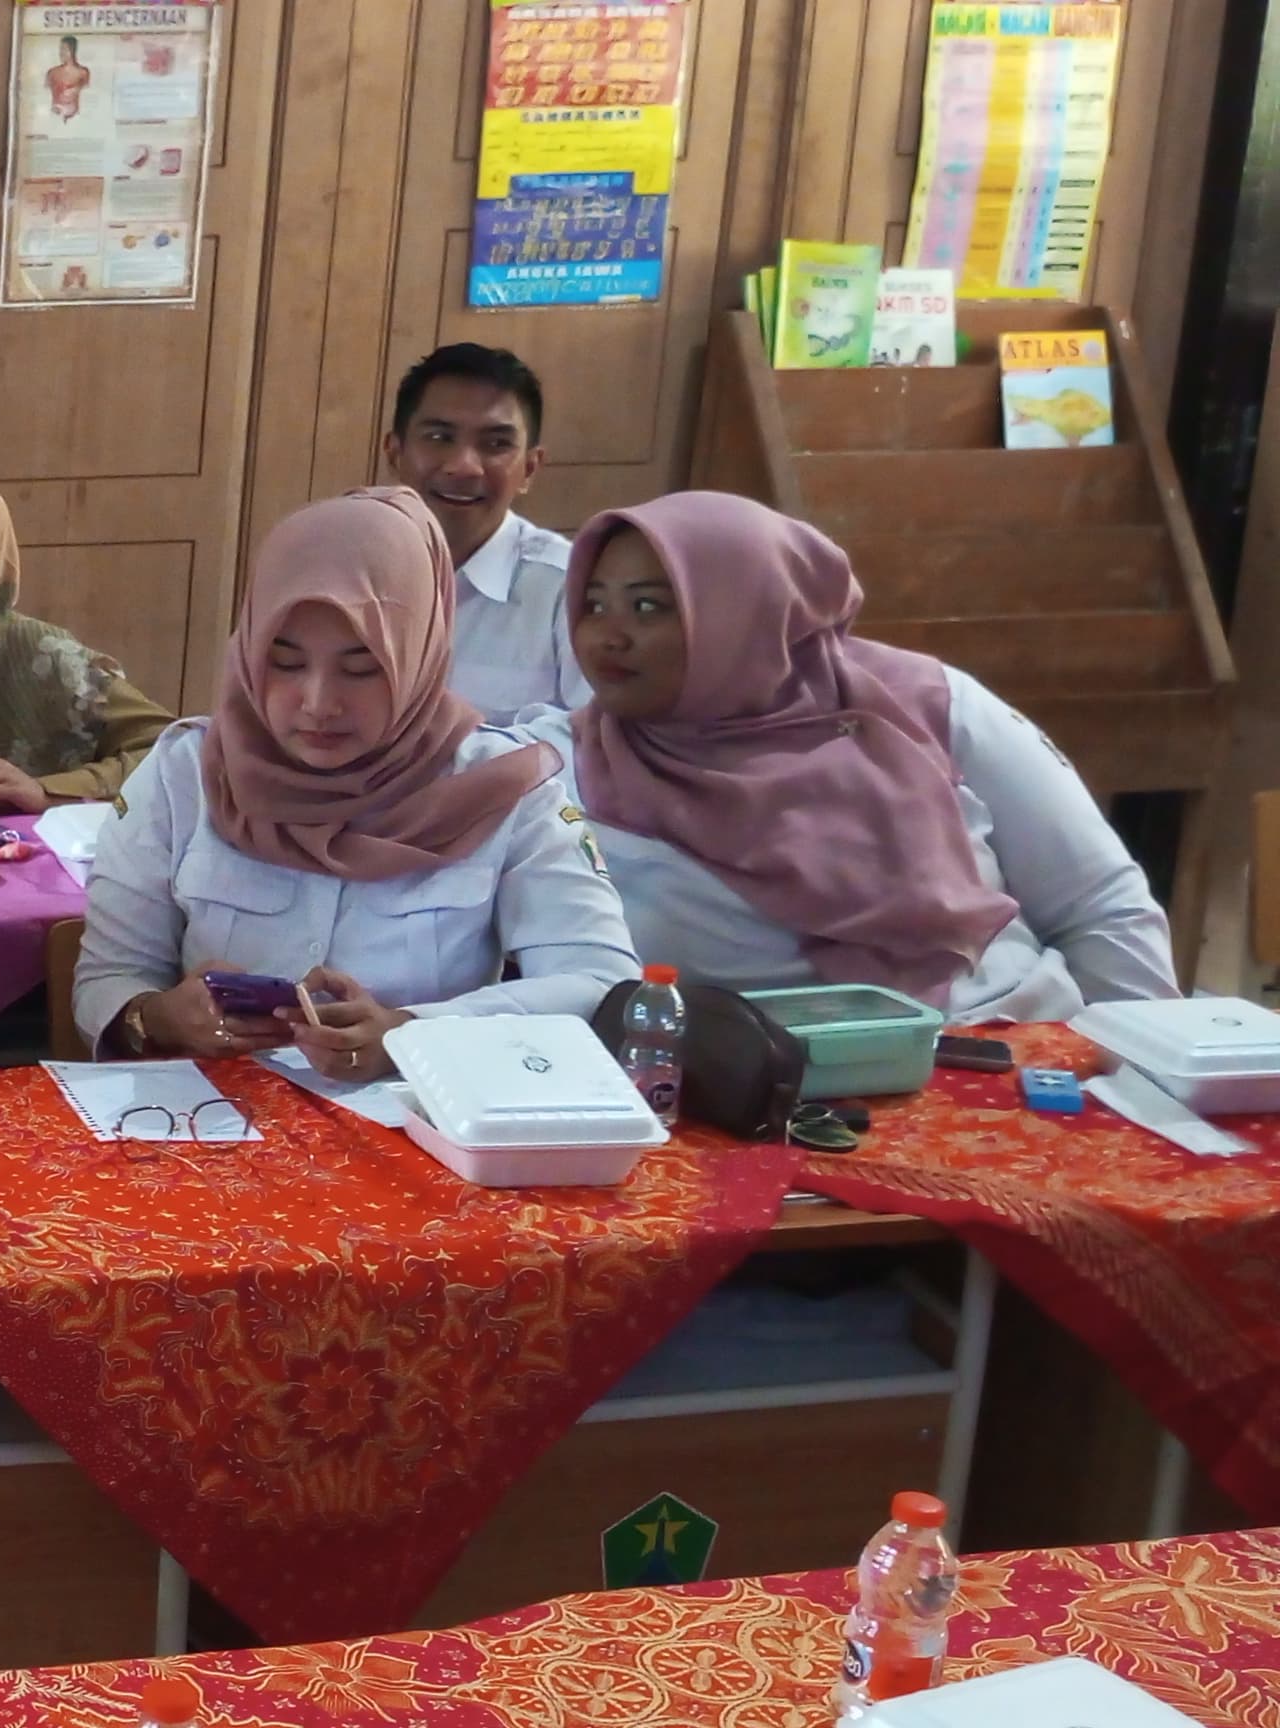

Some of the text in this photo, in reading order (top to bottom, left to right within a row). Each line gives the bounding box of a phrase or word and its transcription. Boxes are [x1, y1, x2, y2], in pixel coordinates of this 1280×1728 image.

[43, 9, 188, 28] SISTEM PENCERNAAN
[1004, 340, 1081, 360] ATLAS
